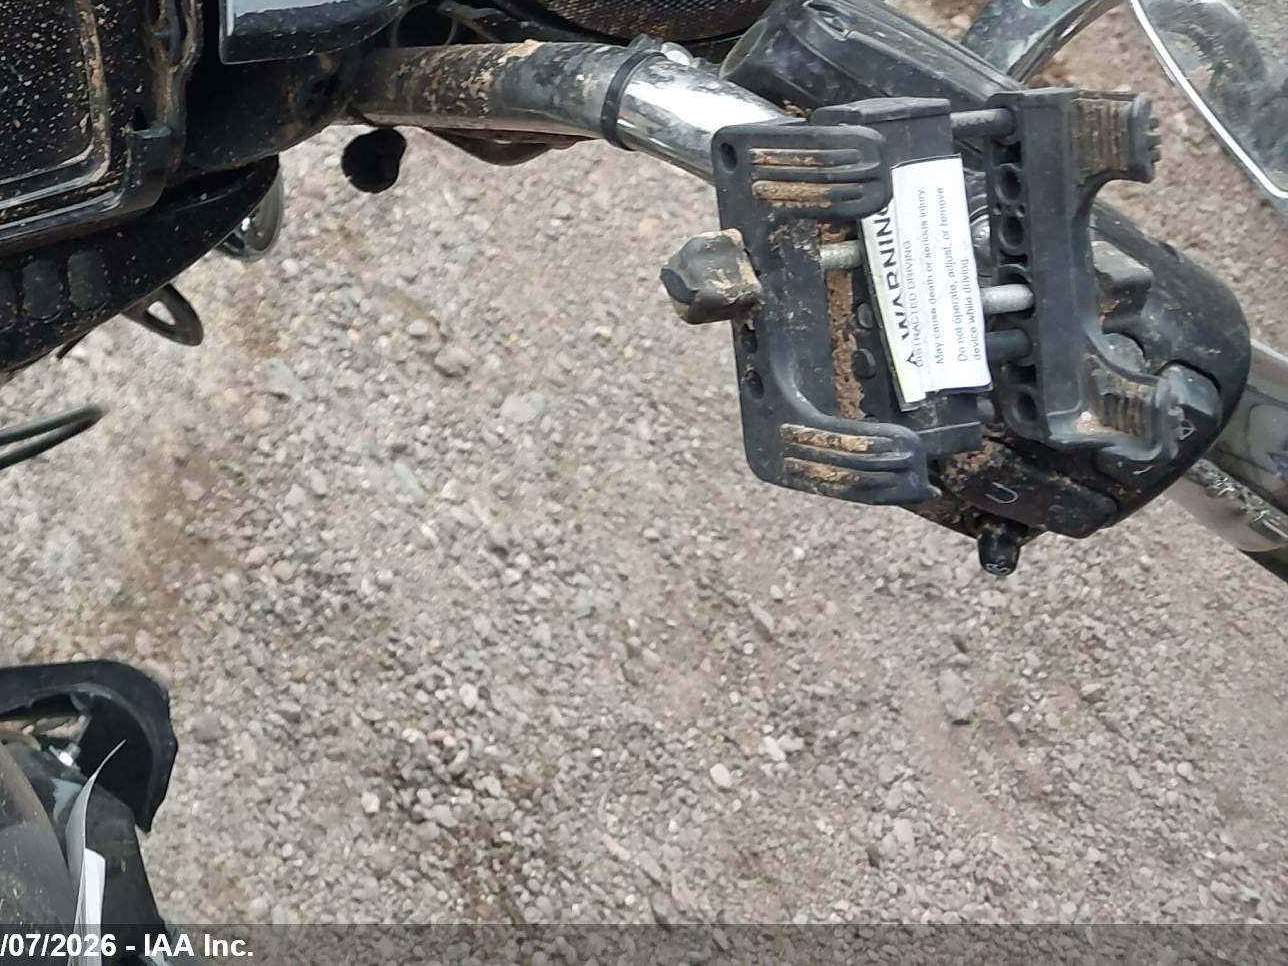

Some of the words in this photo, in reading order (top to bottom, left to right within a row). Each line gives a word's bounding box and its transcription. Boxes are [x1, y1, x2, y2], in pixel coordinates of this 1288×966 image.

[937, 187, 948, 226] remove
[920, 220, 931, 258] serious
[942, 230, 950, 240] or
[903, 240, 915, 290] DRIVING
[925, 262, 933, 272] or
[927, 275, 936, 304] death
[931, 307, 942, 339] cause
[965, 296, 975, 324] while
[953, 327, 964, 344] not
[970, 326, 981, 361] device
[935, 342, 945, 365] May
[957, 346, 968, 362] Do
